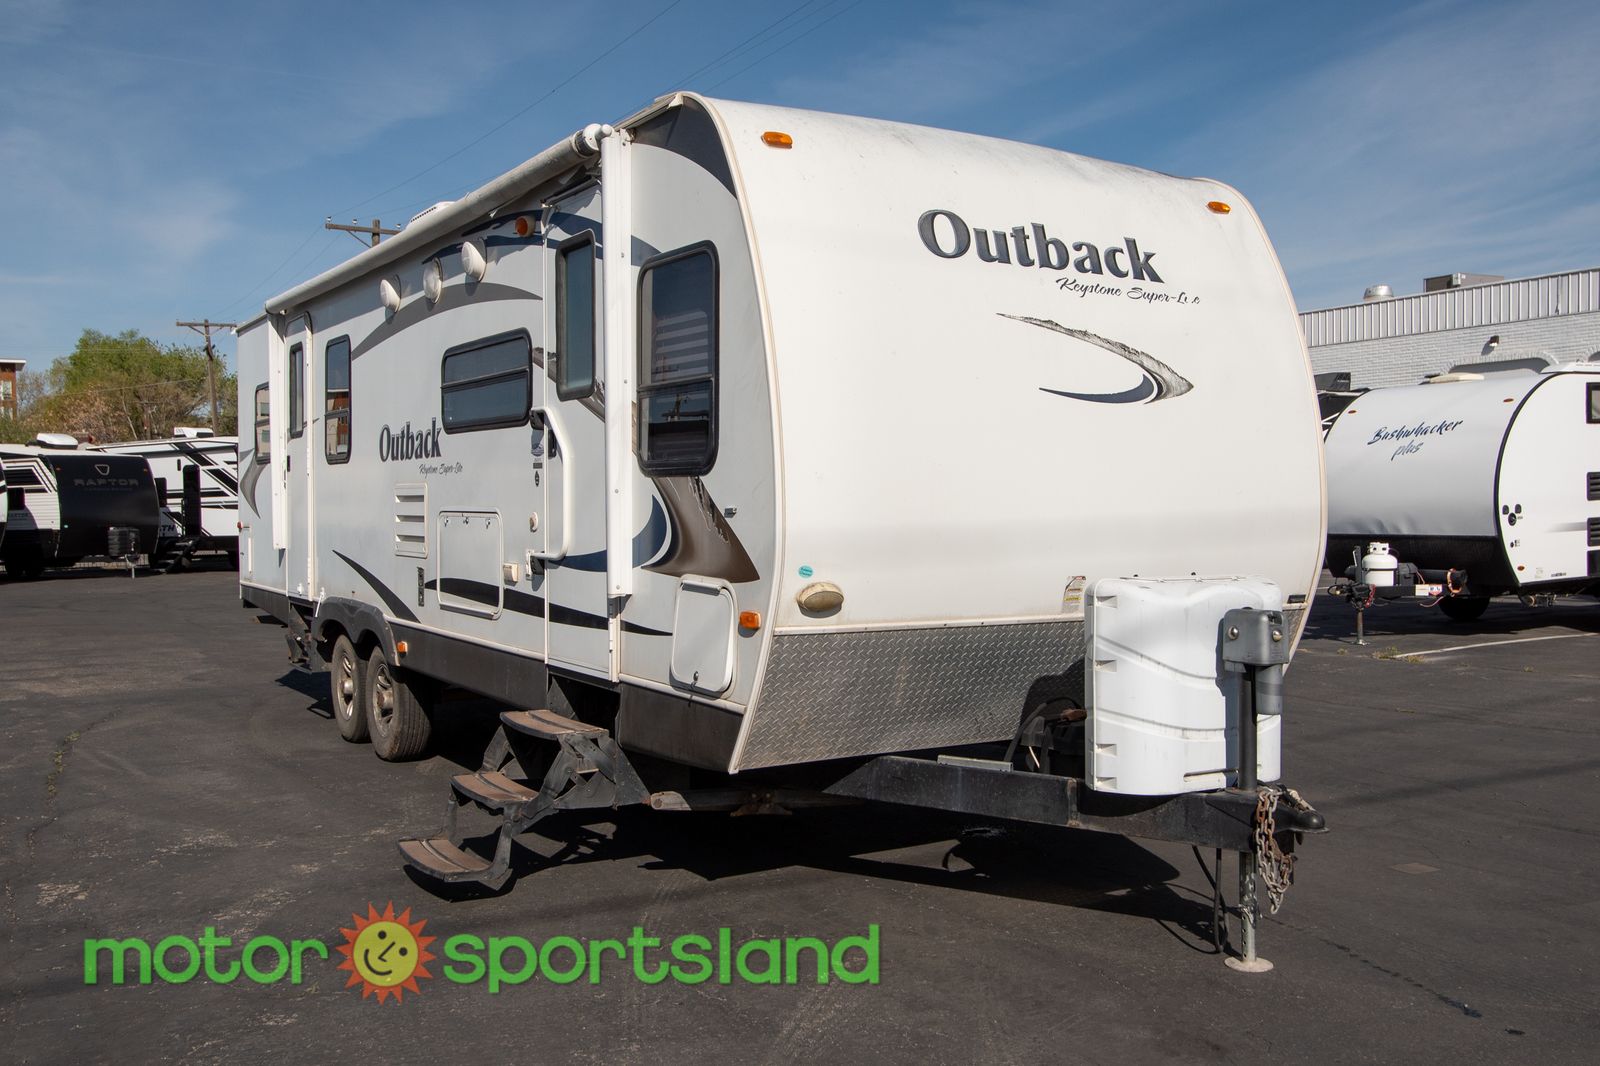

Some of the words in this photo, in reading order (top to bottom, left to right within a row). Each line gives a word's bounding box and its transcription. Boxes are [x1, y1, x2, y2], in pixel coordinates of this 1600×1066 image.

[917, 208, 1165, 284] Outback
[1055, 276, 1122, 298] Keystone
[1126, 286, 1201, 305] Super-Lie
[379, 417, 442, 463] Outback
[1367, 419, 1464, 445] Bushwhacker
[1390, 439, 1424, 461] plus
[73, 478, 140, 487] RAPTOR
